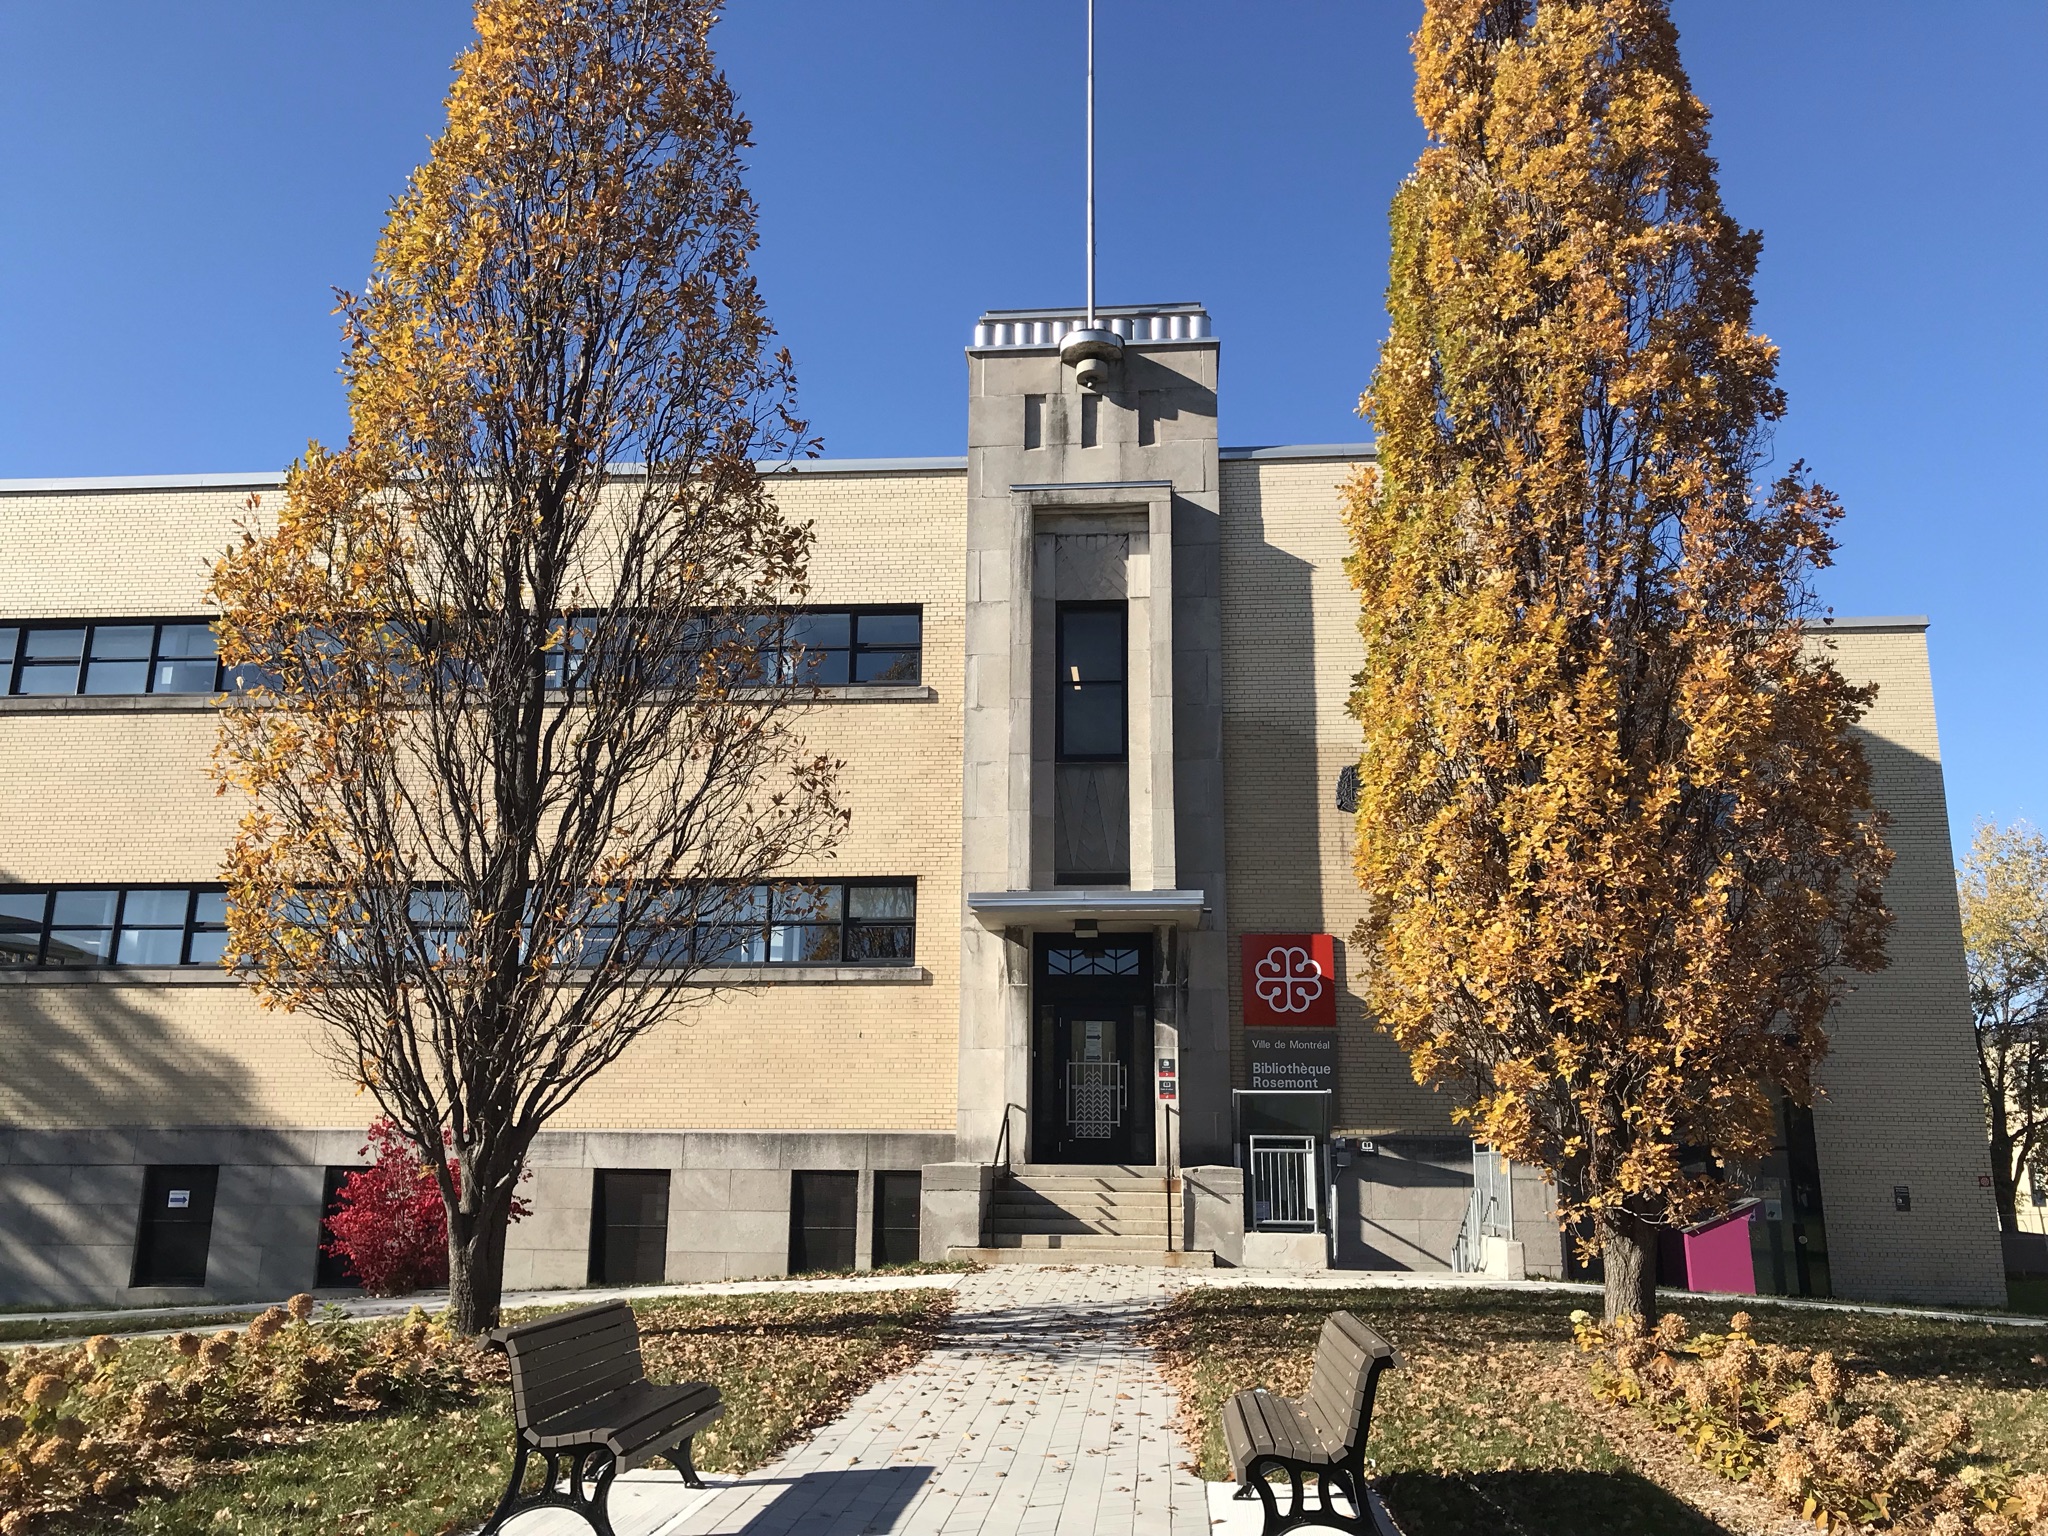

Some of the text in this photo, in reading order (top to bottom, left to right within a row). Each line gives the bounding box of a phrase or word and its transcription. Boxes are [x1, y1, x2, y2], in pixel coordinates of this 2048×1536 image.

[1251, 1039, 1330, 1050] Ville de Montréal
[1252, 1062, 1331, 1077] Bibliothèque
[1252, 1076, 1319, 1088] Rosemont
